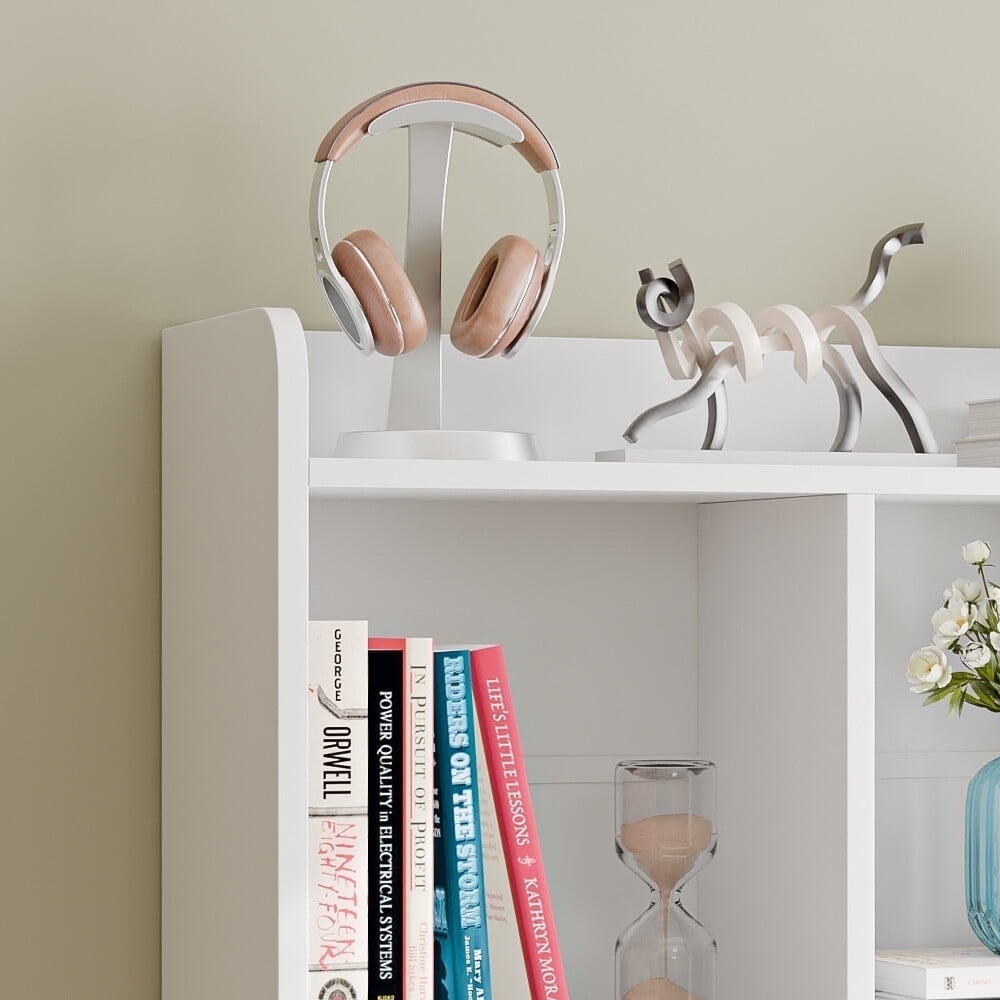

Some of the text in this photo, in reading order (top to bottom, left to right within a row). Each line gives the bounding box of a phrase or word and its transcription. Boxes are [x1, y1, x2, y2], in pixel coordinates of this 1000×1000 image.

[334, 629, 342, 702] GEORGE
[486, 677, 507, 722] LIFE'S
[322, 726, 352, 800] ORWELL
[410, 665, 427, 892] IN PURSUIT OF PROFIT
[494, 723, 518, 777] LITTLE
[444, 656, 482, 930] RIDERS ON THE STORM
[503, 782, 530, 847] LESSONS
[376, 690, 393, 980] POWER QUALITY in ELECTRICAL SYSTEMS
[316, 820, 337, 971] EIGHTY-FOUR
[335, 822, 358, 964] NINETEEN
[523, 877, 552, 956] KATHRYN
[473, 948, 482, 984] Mary
